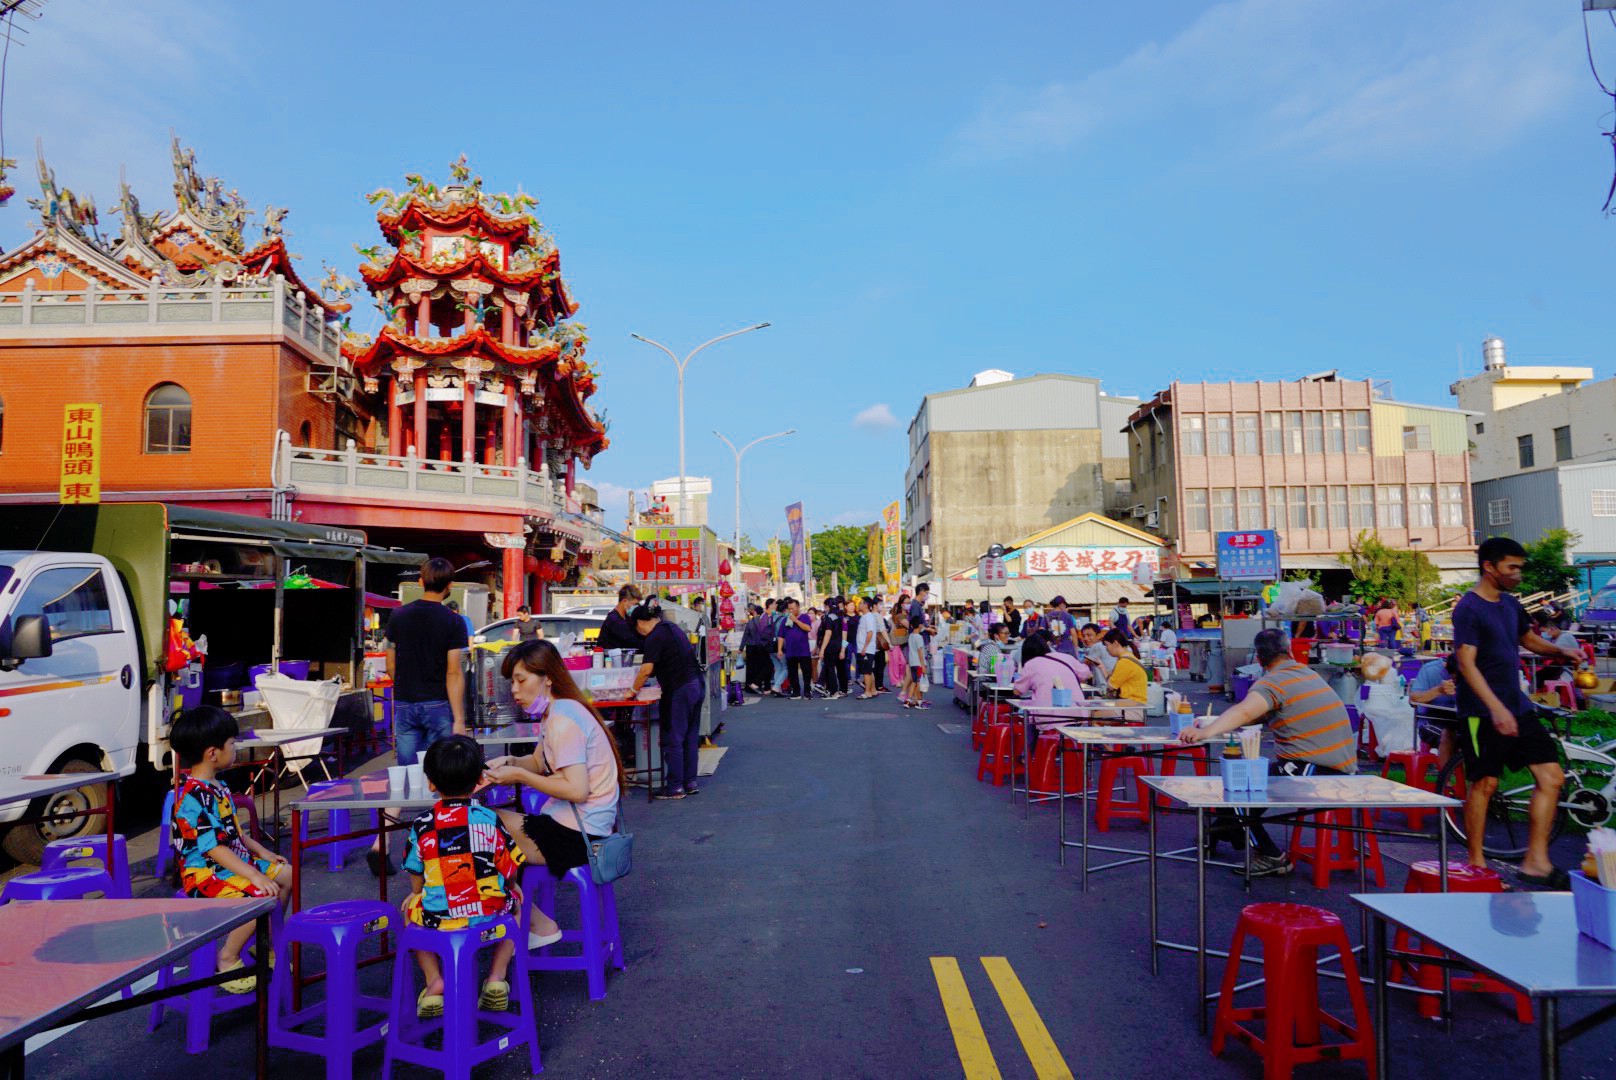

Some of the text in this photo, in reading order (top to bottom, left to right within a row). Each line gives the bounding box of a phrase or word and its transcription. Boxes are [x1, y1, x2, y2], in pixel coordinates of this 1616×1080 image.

[63, 408, 95, 475] 東山鴨頭
[1028, 550, 1143, 572] 趙金城名刀
